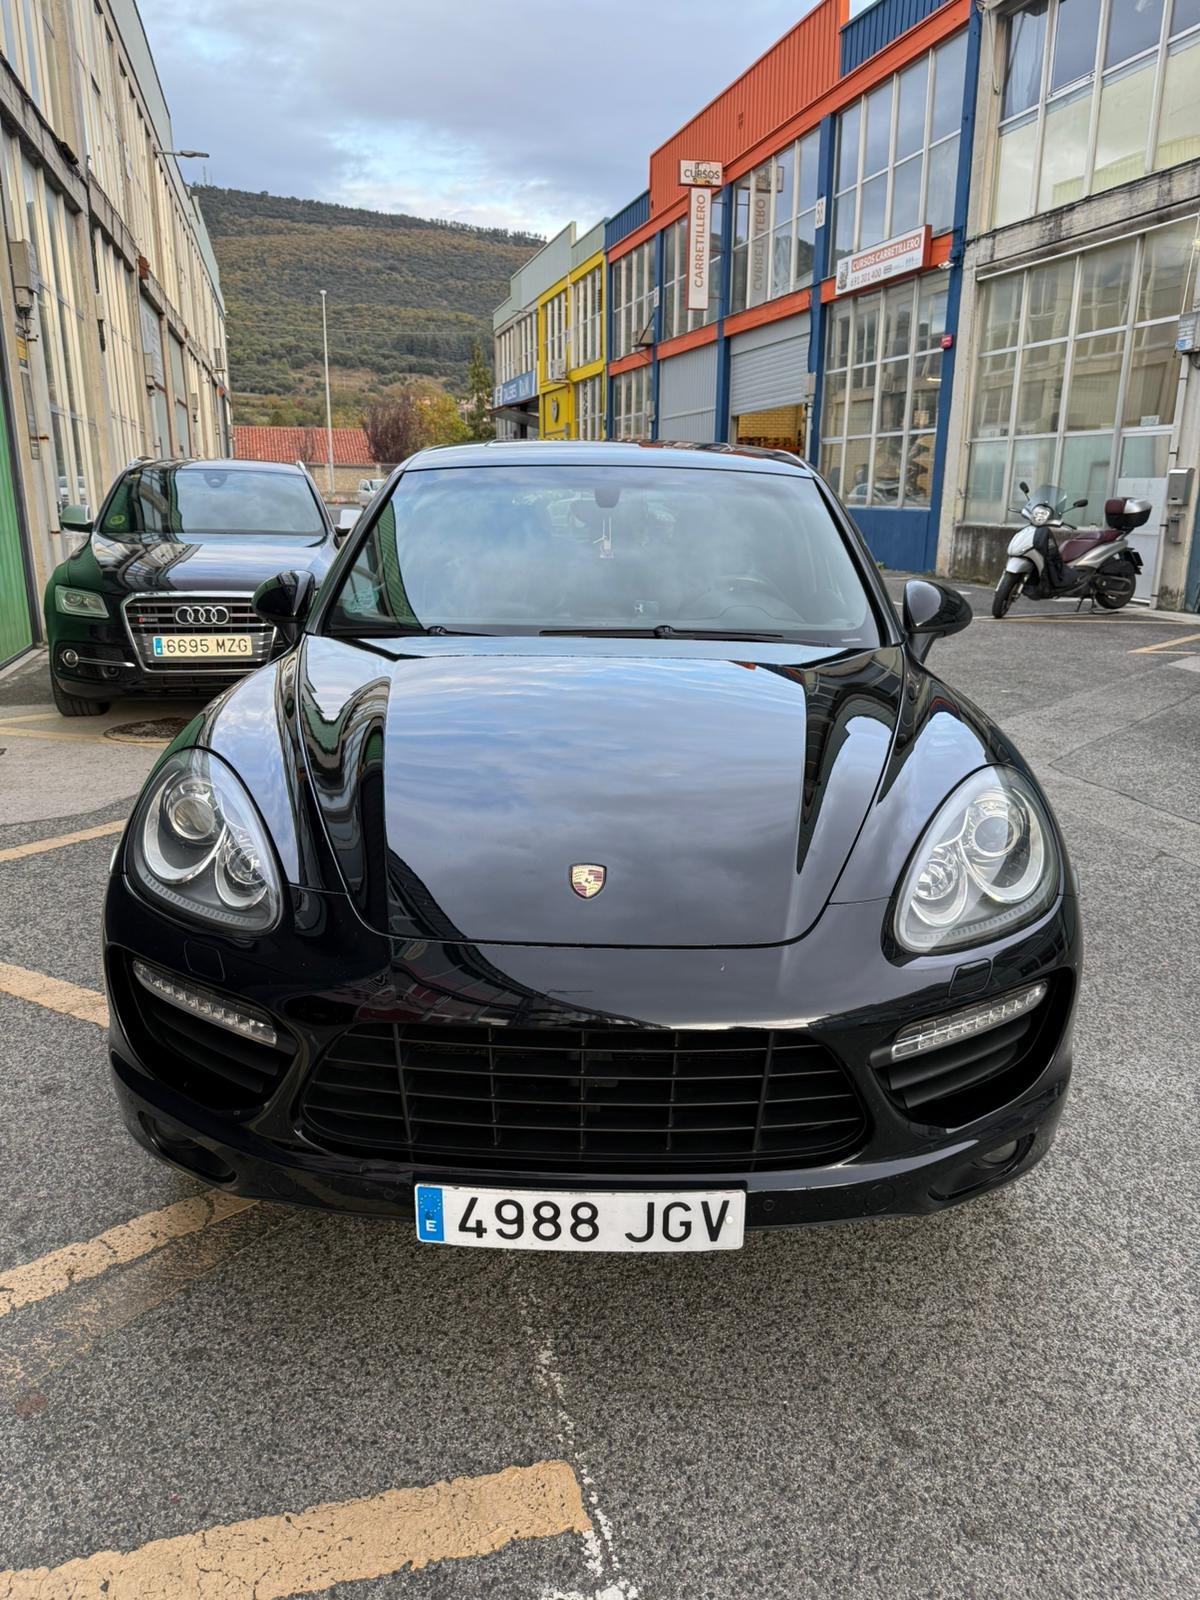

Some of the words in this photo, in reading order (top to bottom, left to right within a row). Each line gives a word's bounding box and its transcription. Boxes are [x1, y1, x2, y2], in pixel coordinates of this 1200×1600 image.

[684, 168, 721, 180] CURSOS
[694, 194, 706, 288] CARRETILLERO
[852, 253, 875, 271] CURSOS
[875, 237, 920, 261] CARRETILLERO
[166, 638, 210, 653] 6695
[216, 638, 248, 653] MZG
[425, 1219, 438, 1232] E
[457, 1196, 600, 1243] 4988
[624, 1199, 730, 1243] JGV
